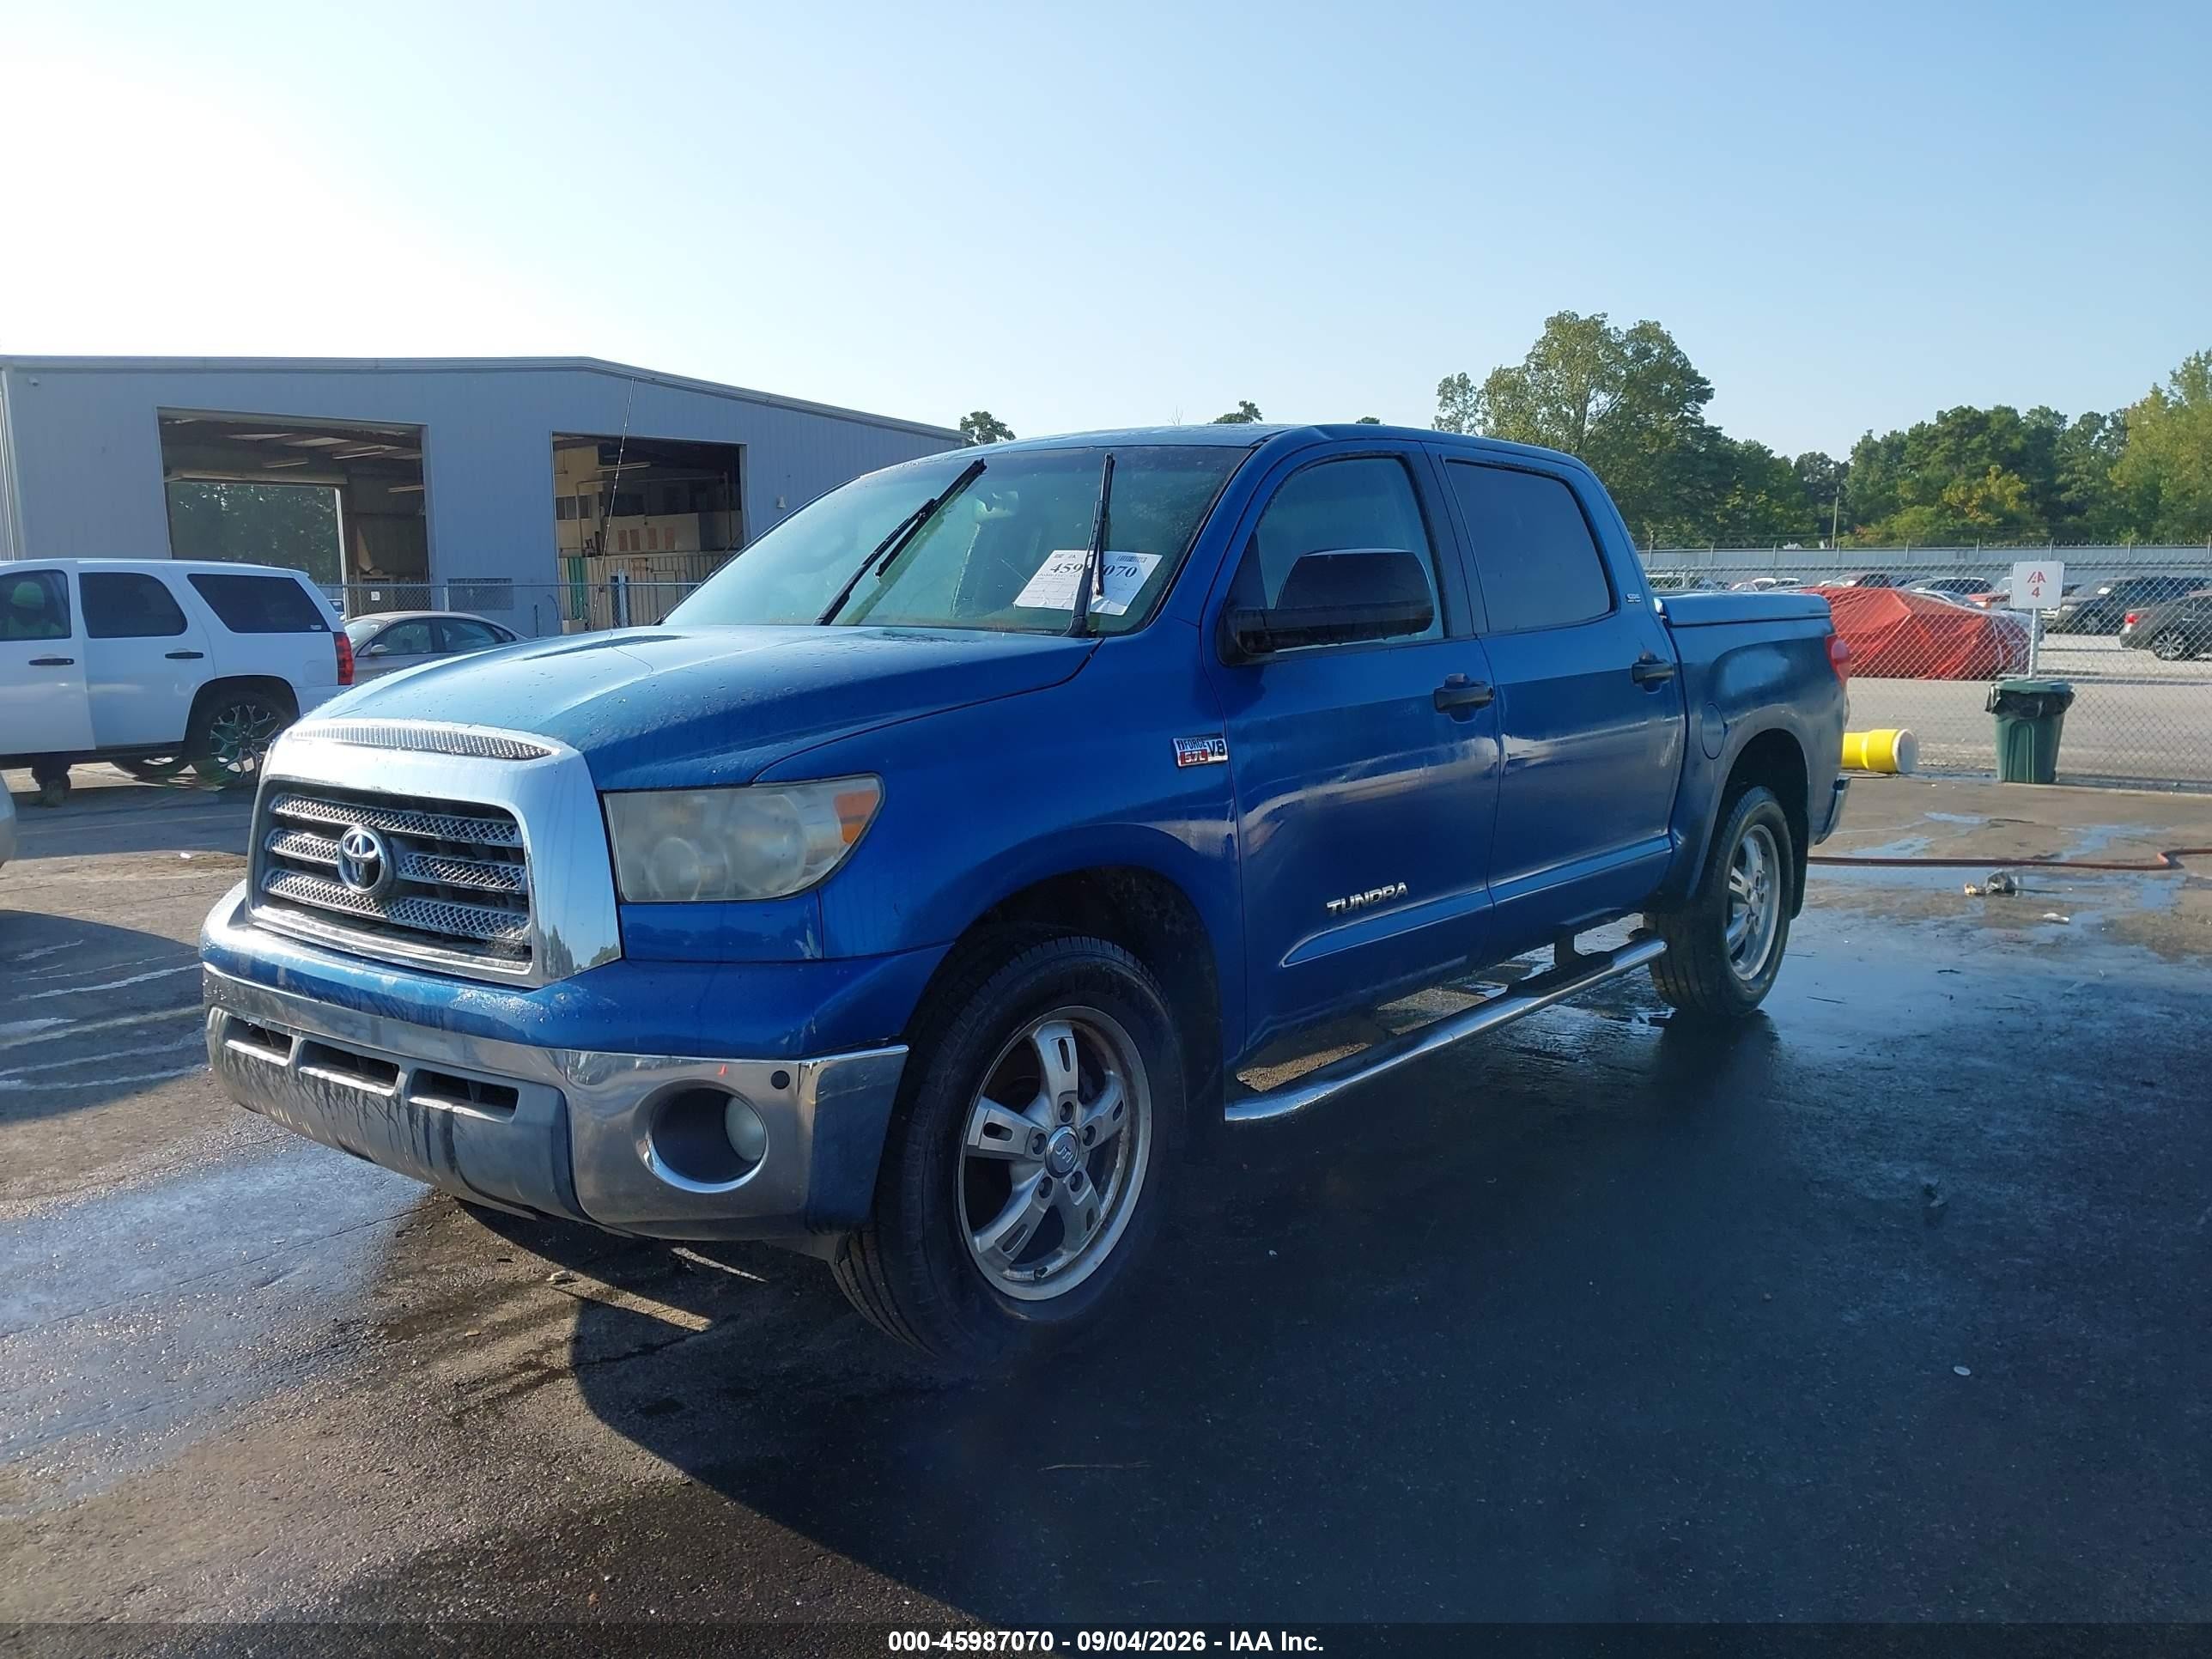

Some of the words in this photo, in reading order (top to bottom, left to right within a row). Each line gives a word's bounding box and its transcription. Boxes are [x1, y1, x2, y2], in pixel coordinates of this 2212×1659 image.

[1050, 562, 1138, 578] 459070
[2032, 586, 2041, 599] 4
[1206, 739, 1226, 757] V8
[1327, 882, 1408, 914] TUNDRA
